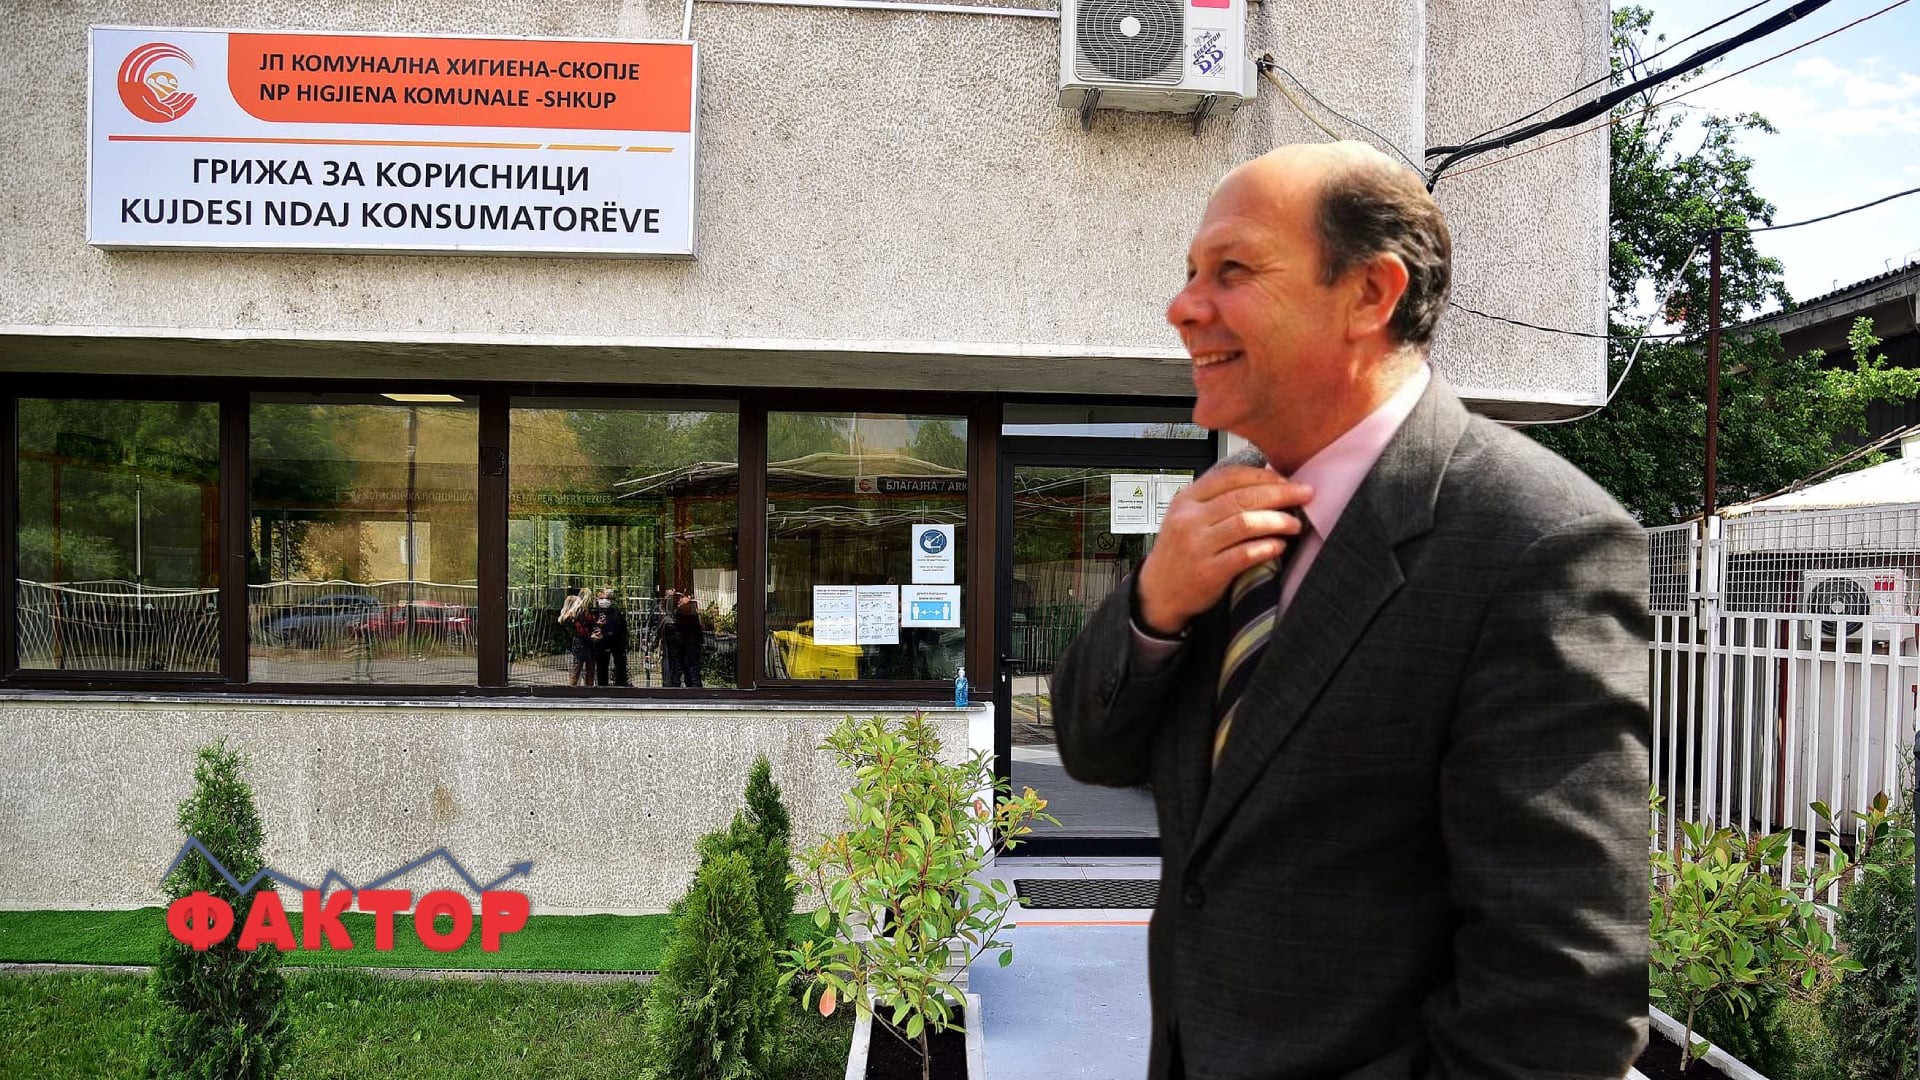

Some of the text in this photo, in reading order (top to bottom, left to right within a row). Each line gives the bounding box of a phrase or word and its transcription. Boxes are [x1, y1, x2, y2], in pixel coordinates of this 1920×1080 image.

[259, 54, 640, 80] ЈП КОМУНАЛНА ХИГИЕНА-СКОПЈЕ
[260, 84, 617, 108] NP HIGJIENA KOMUNALE -SHKUP
[193, 159, 589, 194] ГРИЖА ЗА КОРИСНИЦИ
[121, 199, 660, 234] KUJDESI NDAJ KONSUMATORËVE
[886, 480, 938, 491] БЛАГАЈНА
